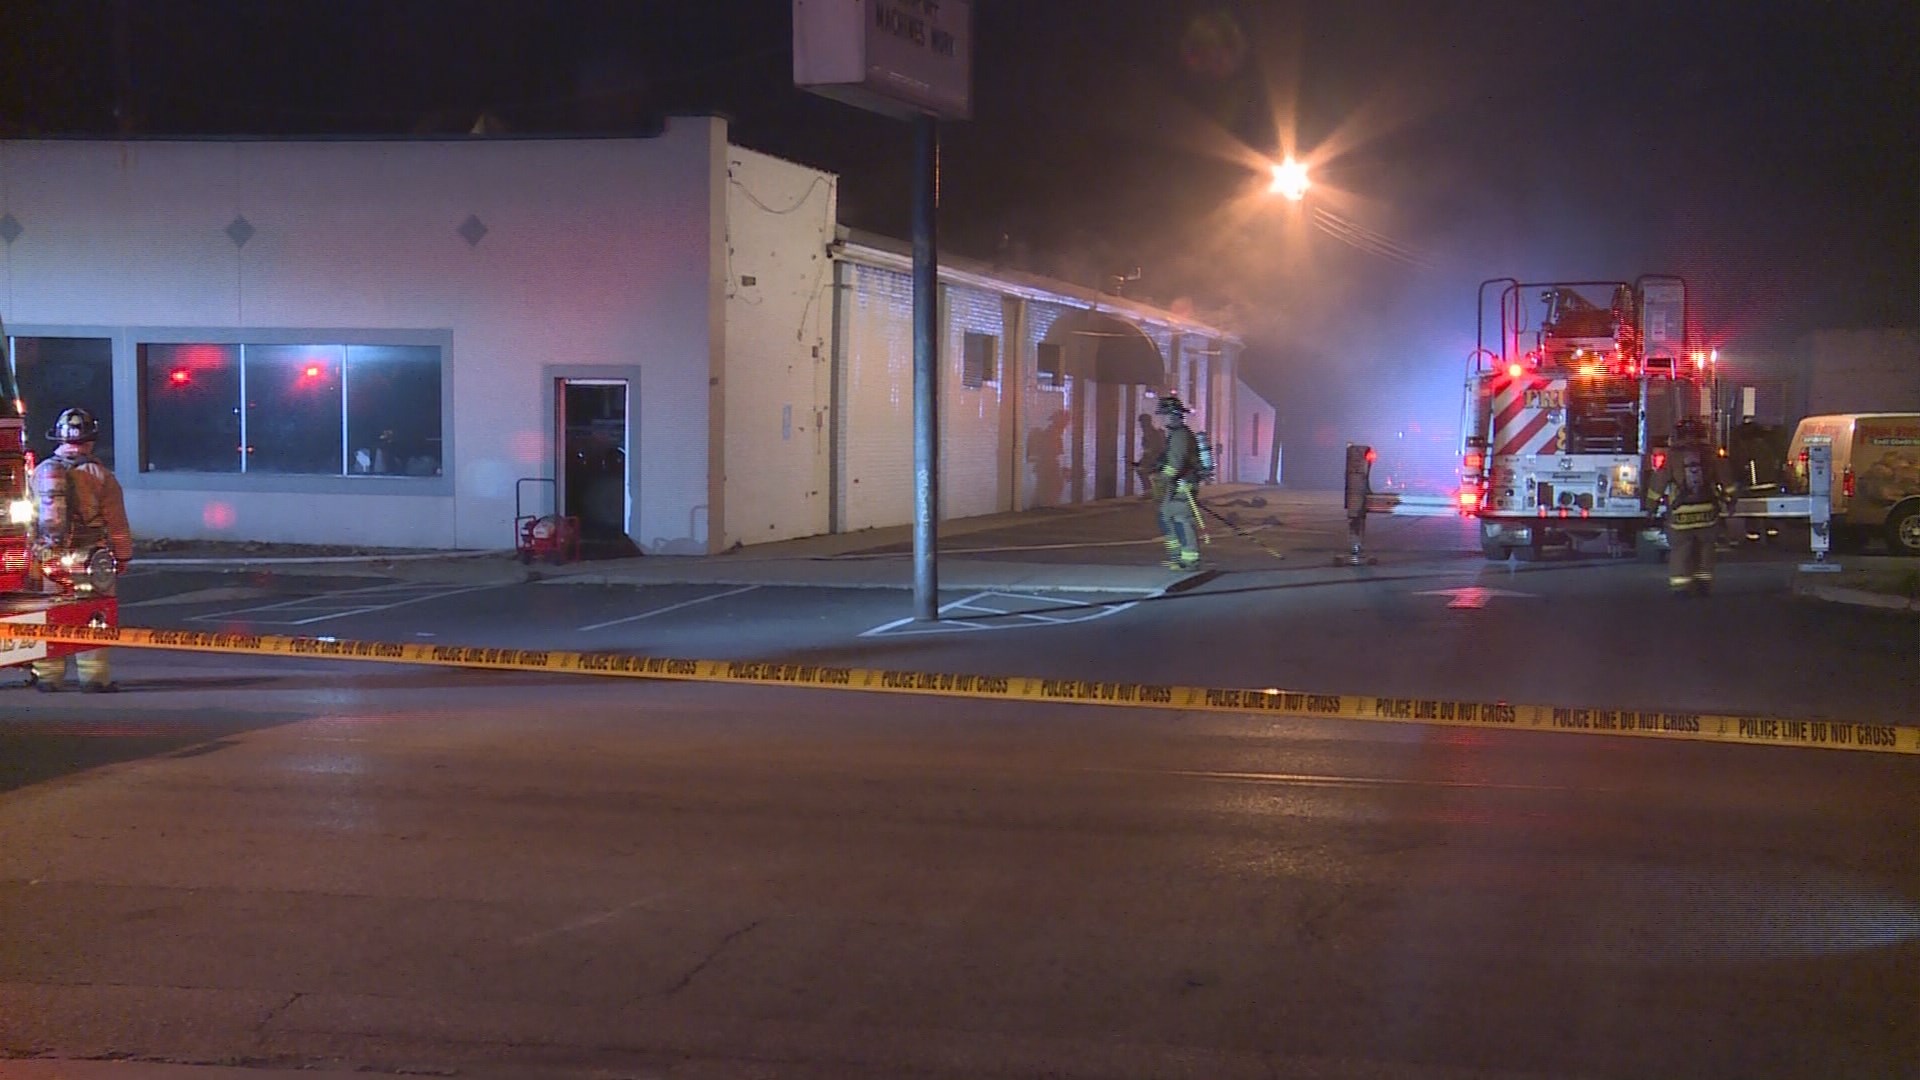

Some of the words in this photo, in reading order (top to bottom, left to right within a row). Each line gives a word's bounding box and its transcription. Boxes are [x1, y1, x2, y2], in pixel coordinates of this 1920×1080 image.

[578, 655, 608, 670] POLICE
[611, 656, 630, 671] LINE
[632, 657, 645, 672] DO
[647, 658, 664, 673] NOT
[667, 659, 697, 675] CROSS
[728, 663, 759, 679] POLICE
[761, 664, 781, 680] LINE
[784, 665, 796, 681] DO
[799, 666, 816, 682] NOT
[819, 668, 849, 684] CROSS
[882, 671, 914, 688] POLICE
[917, 672, 938, 690] LINE
[940, 673, 953, 691] DO
[955, 674, 974, 692] NOT
[976, 675, 1007, 693] CROSS
[1041, 680, 1075, 697] POLICE
[1077, 681, 1099, 699] LINE
[1101, 682, 1115, 700] DO
[1117, 683, 1137, 701] NOT
[1139, 685, 1171, 703] CROSS
[1206, 689, 1240, 706] POLICE
[1243, 691, 1265, 708] LINE
[1268, 693, 1282, 710] DO
[1285, 694, 1304, 711] NOT
[1306, 695, 1340, 713] CROSS
[1376, 698, 1411, 718] POLICE
[1414, 699, 1437, 719] LINE
[1440, 701, 1454, 720] DO
[1457, 702, 1477, 721] NOT
[1481, 704, 1515, 723] CROSS
[1553, 708, 1590, 728] POLICE
[1593, 710, 1616, 730] LINE
[1620, 711, 1635, 730] DO
[1638, 712, 1660, 731] NOT
[1662, 713, 1700, 732] CROSS
[1738, 718, 1777, 738] POLICE
[1781, 720, 1807, 741] LINE
[1810, 721, 1827, 742] DO
[1830, 724, 1854, 744] NOT
[1856, 725, 1896, 747] CROSS
